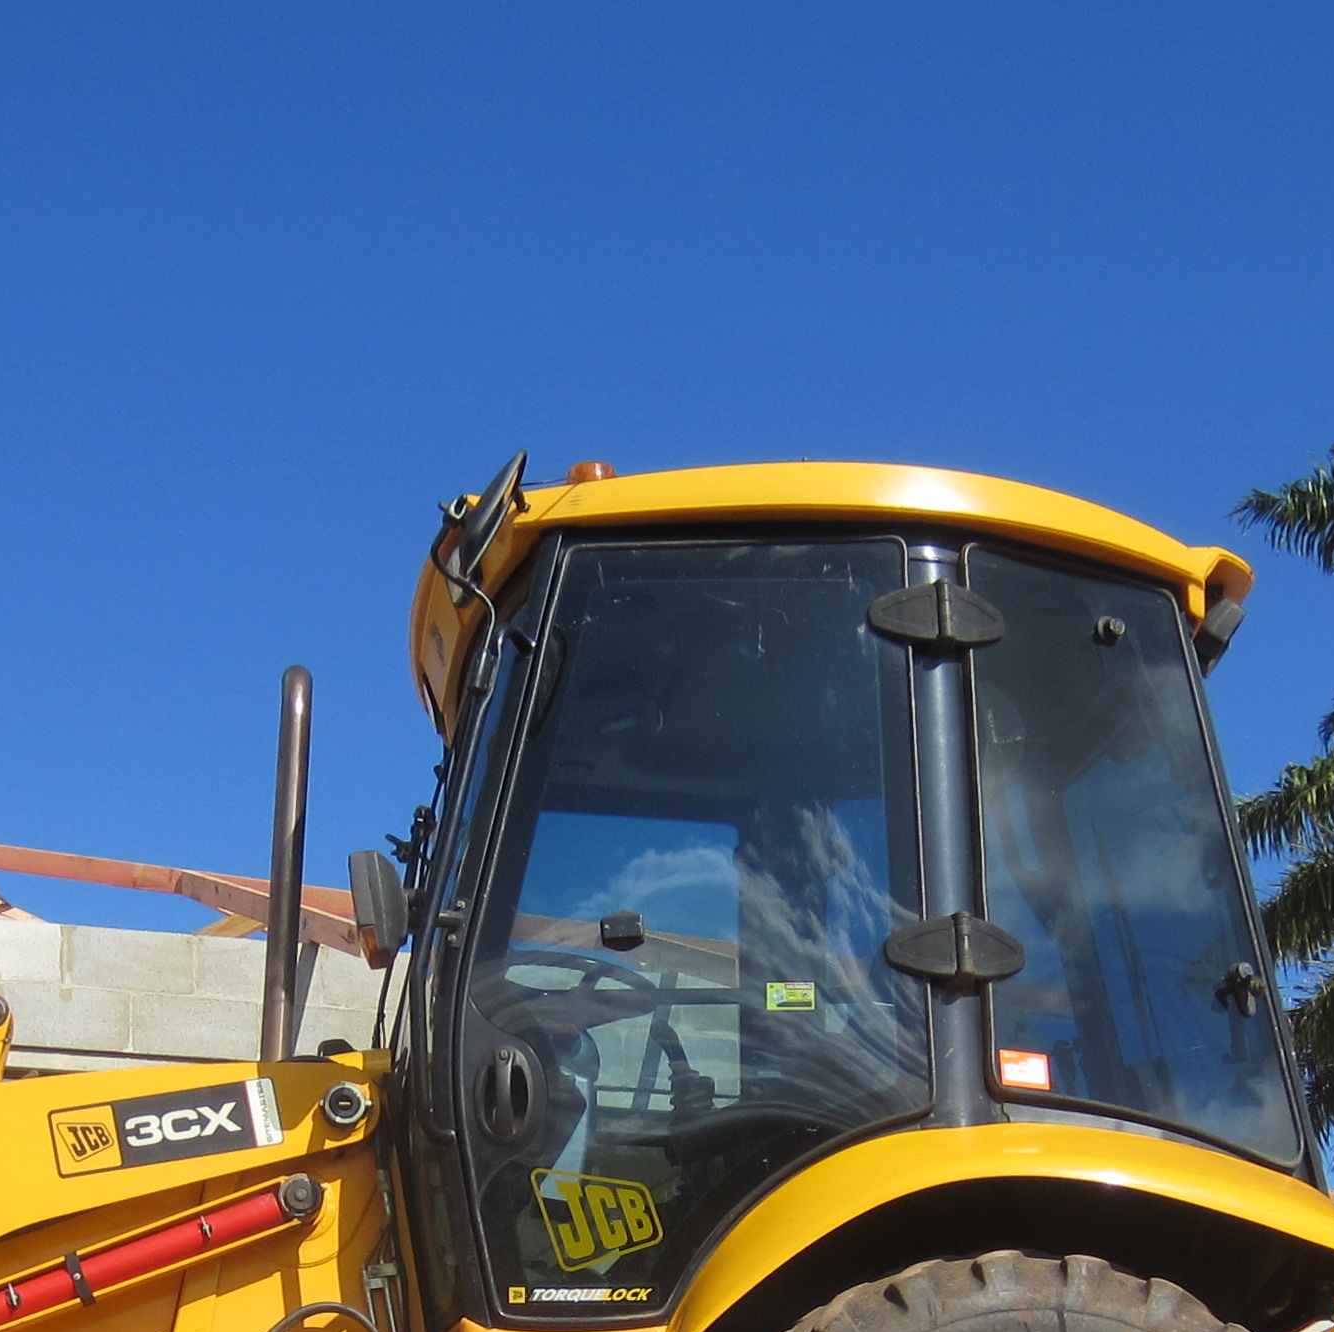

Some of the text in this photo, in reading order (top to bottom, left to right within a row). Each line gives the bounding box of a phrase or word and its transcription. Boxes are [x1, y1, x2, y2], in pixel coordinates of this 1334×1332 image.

[67, 1125, 110, 1157] JCB
[125, 1102, 243, 1147] 3CX
[554, 1180, 654, 1259] JCB
[529, 1288, 653, 1302] TORQUELOCK
